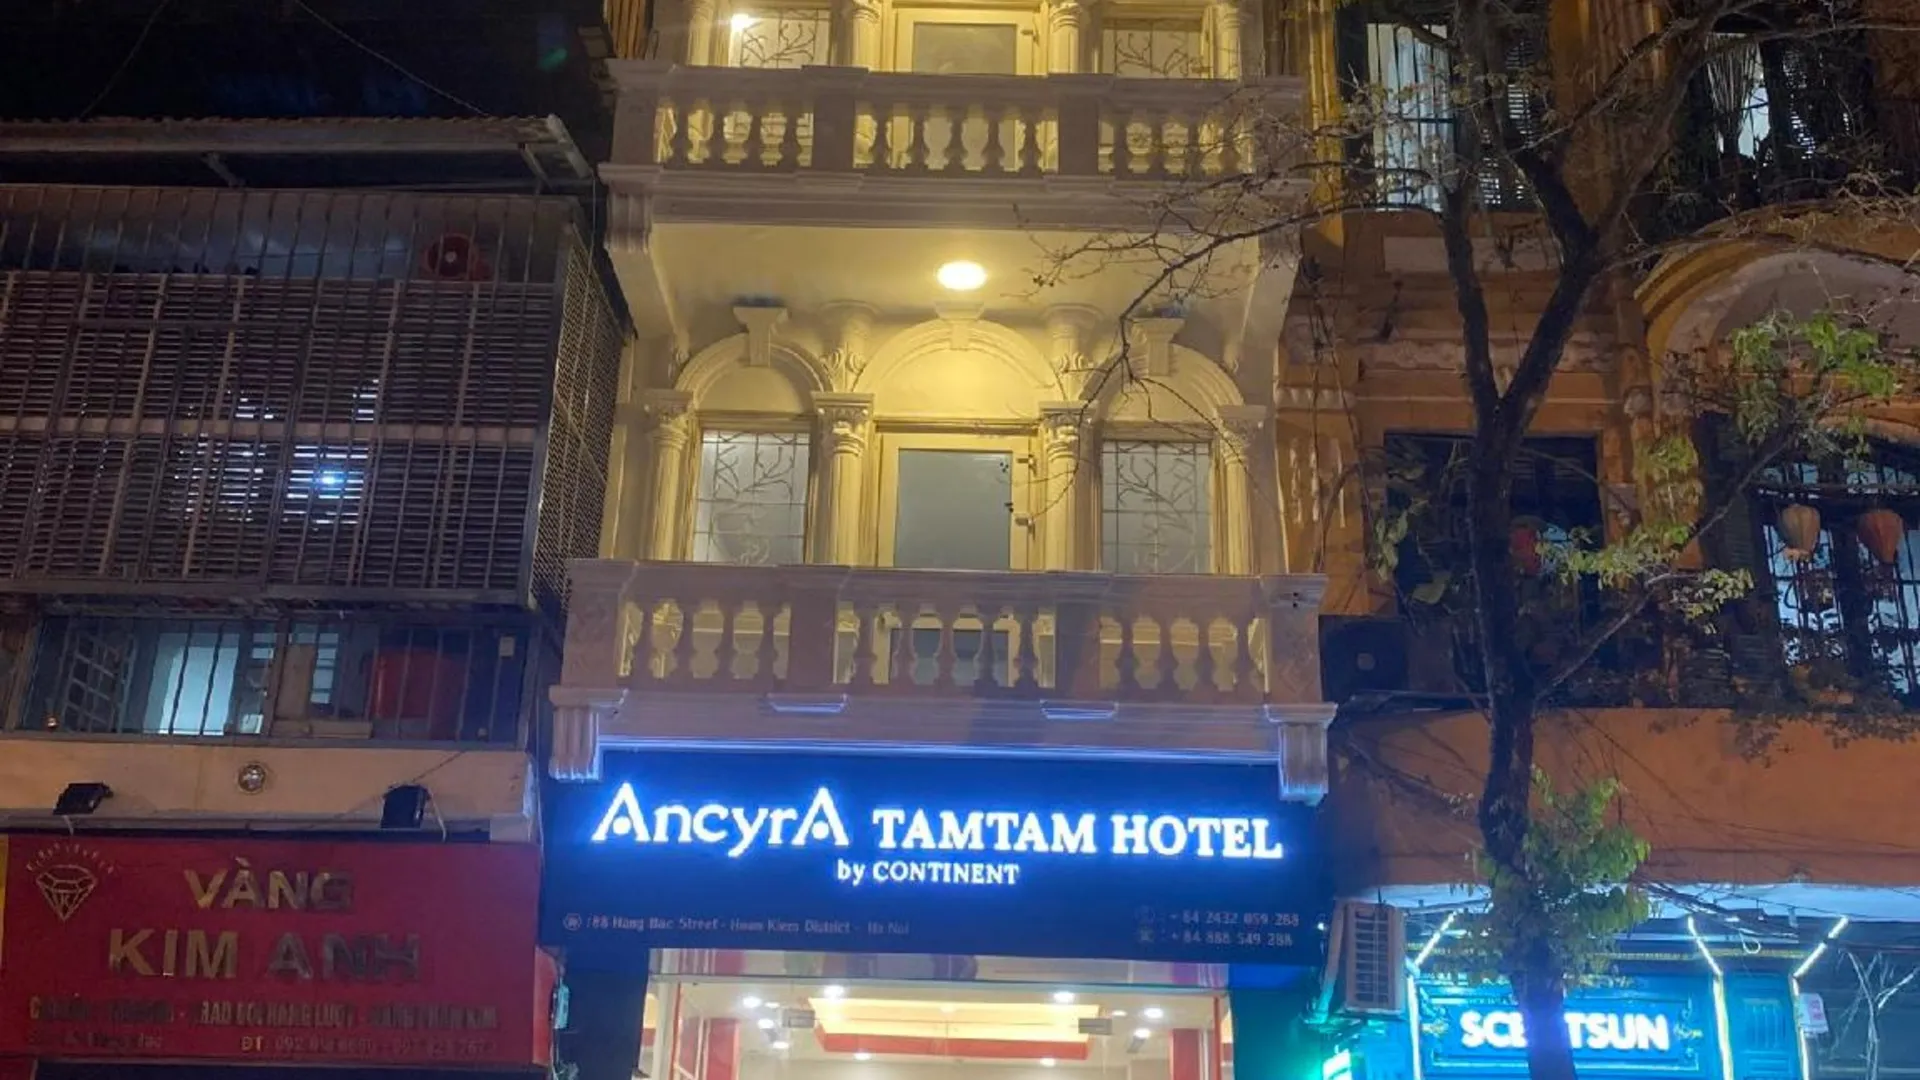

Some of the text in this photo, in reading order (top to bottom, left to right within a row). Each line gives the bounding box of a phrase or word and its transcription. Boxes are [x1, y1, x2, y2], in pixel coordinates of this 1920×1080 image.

[591, 780, 1284, 860] AncyrA TAMTAM HOTEL
[182, 857, 354, 909] VÀNG
[837, 858, 1020, 886] by CONTINENT
[679, 917, 717, 931] Street
[108, 927, 421, 980] KIM ANH
[1460, 1010, 1670, 1051] SCETSUN
